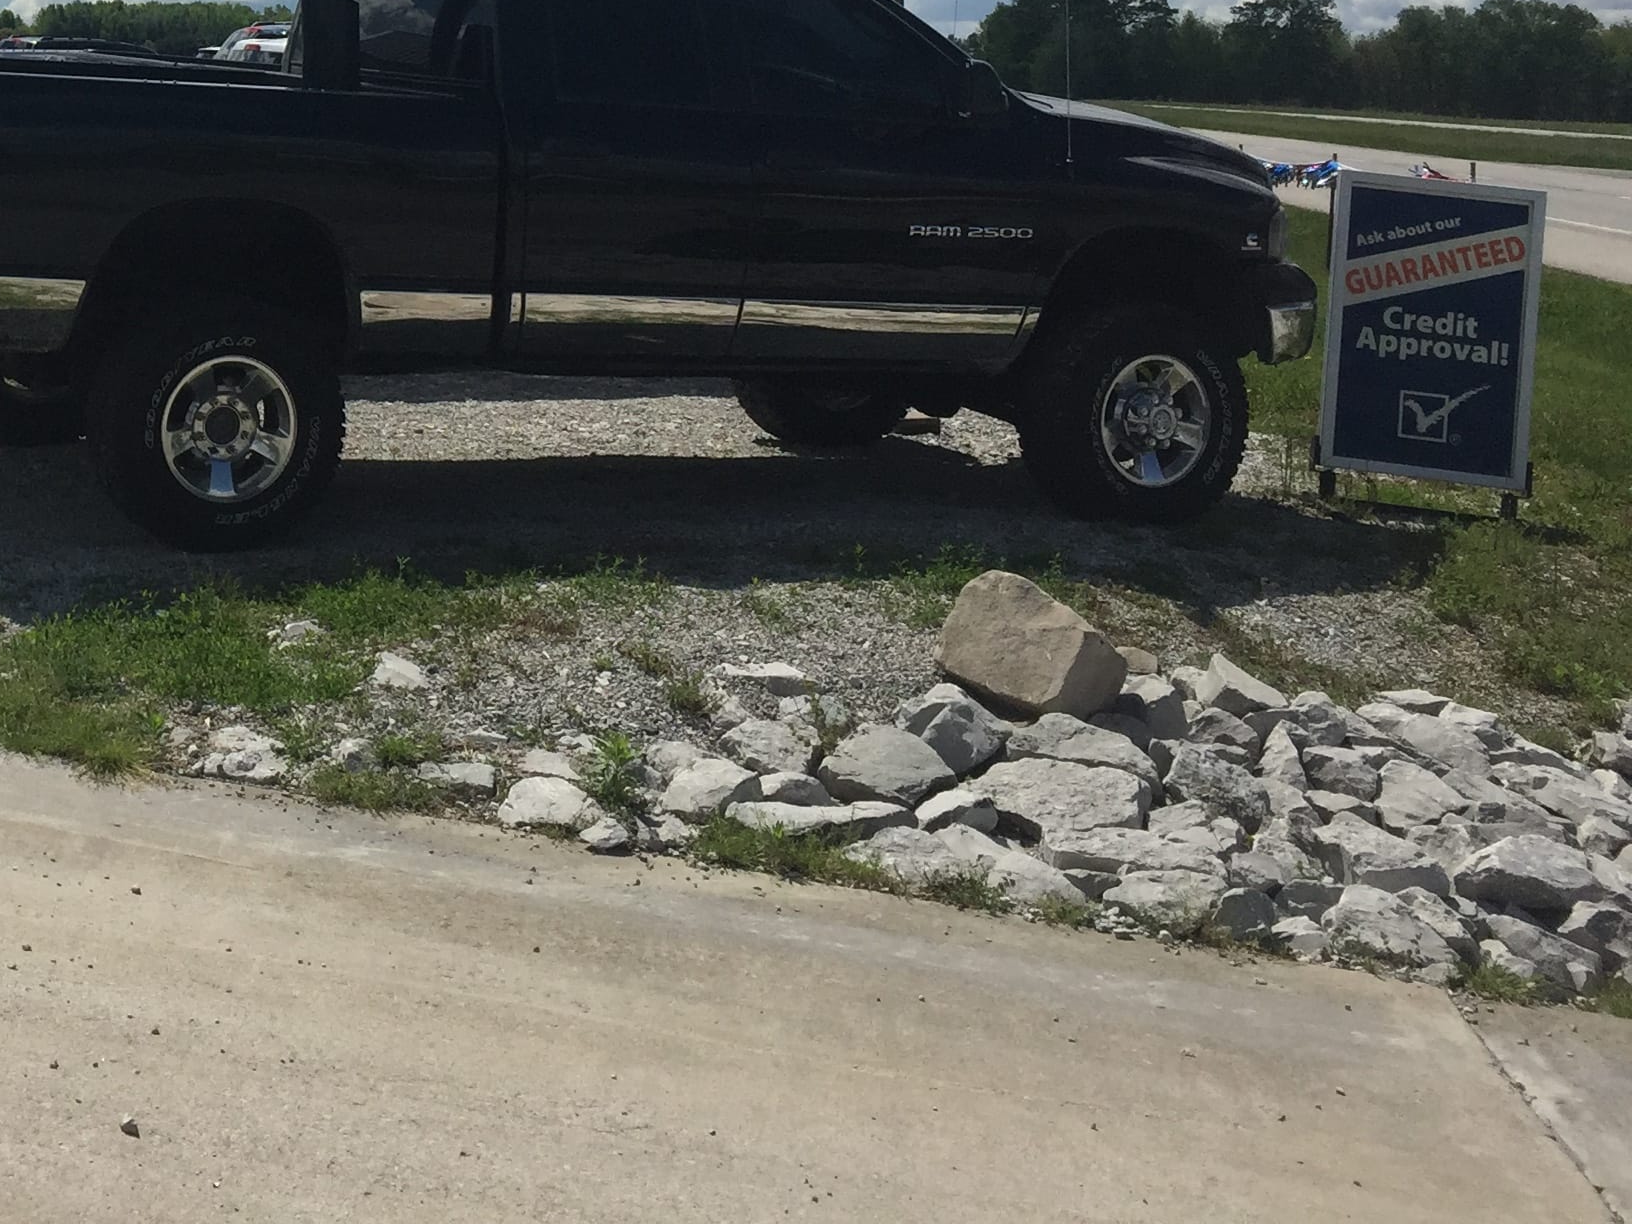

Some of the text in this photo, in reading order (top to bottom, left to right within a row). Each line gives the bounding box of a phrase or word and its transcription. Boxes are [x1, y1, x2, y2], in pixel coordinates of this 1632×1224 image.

[909, 224, 1034, 239] RAM 2500
[1356, 216, 1462, 247] Ask about our
[1344, 236, 1526, 294] GUARANTEED
[1382, 306, 1479, 339] Credit
[1355, 326, 1510, 367] Approval!
